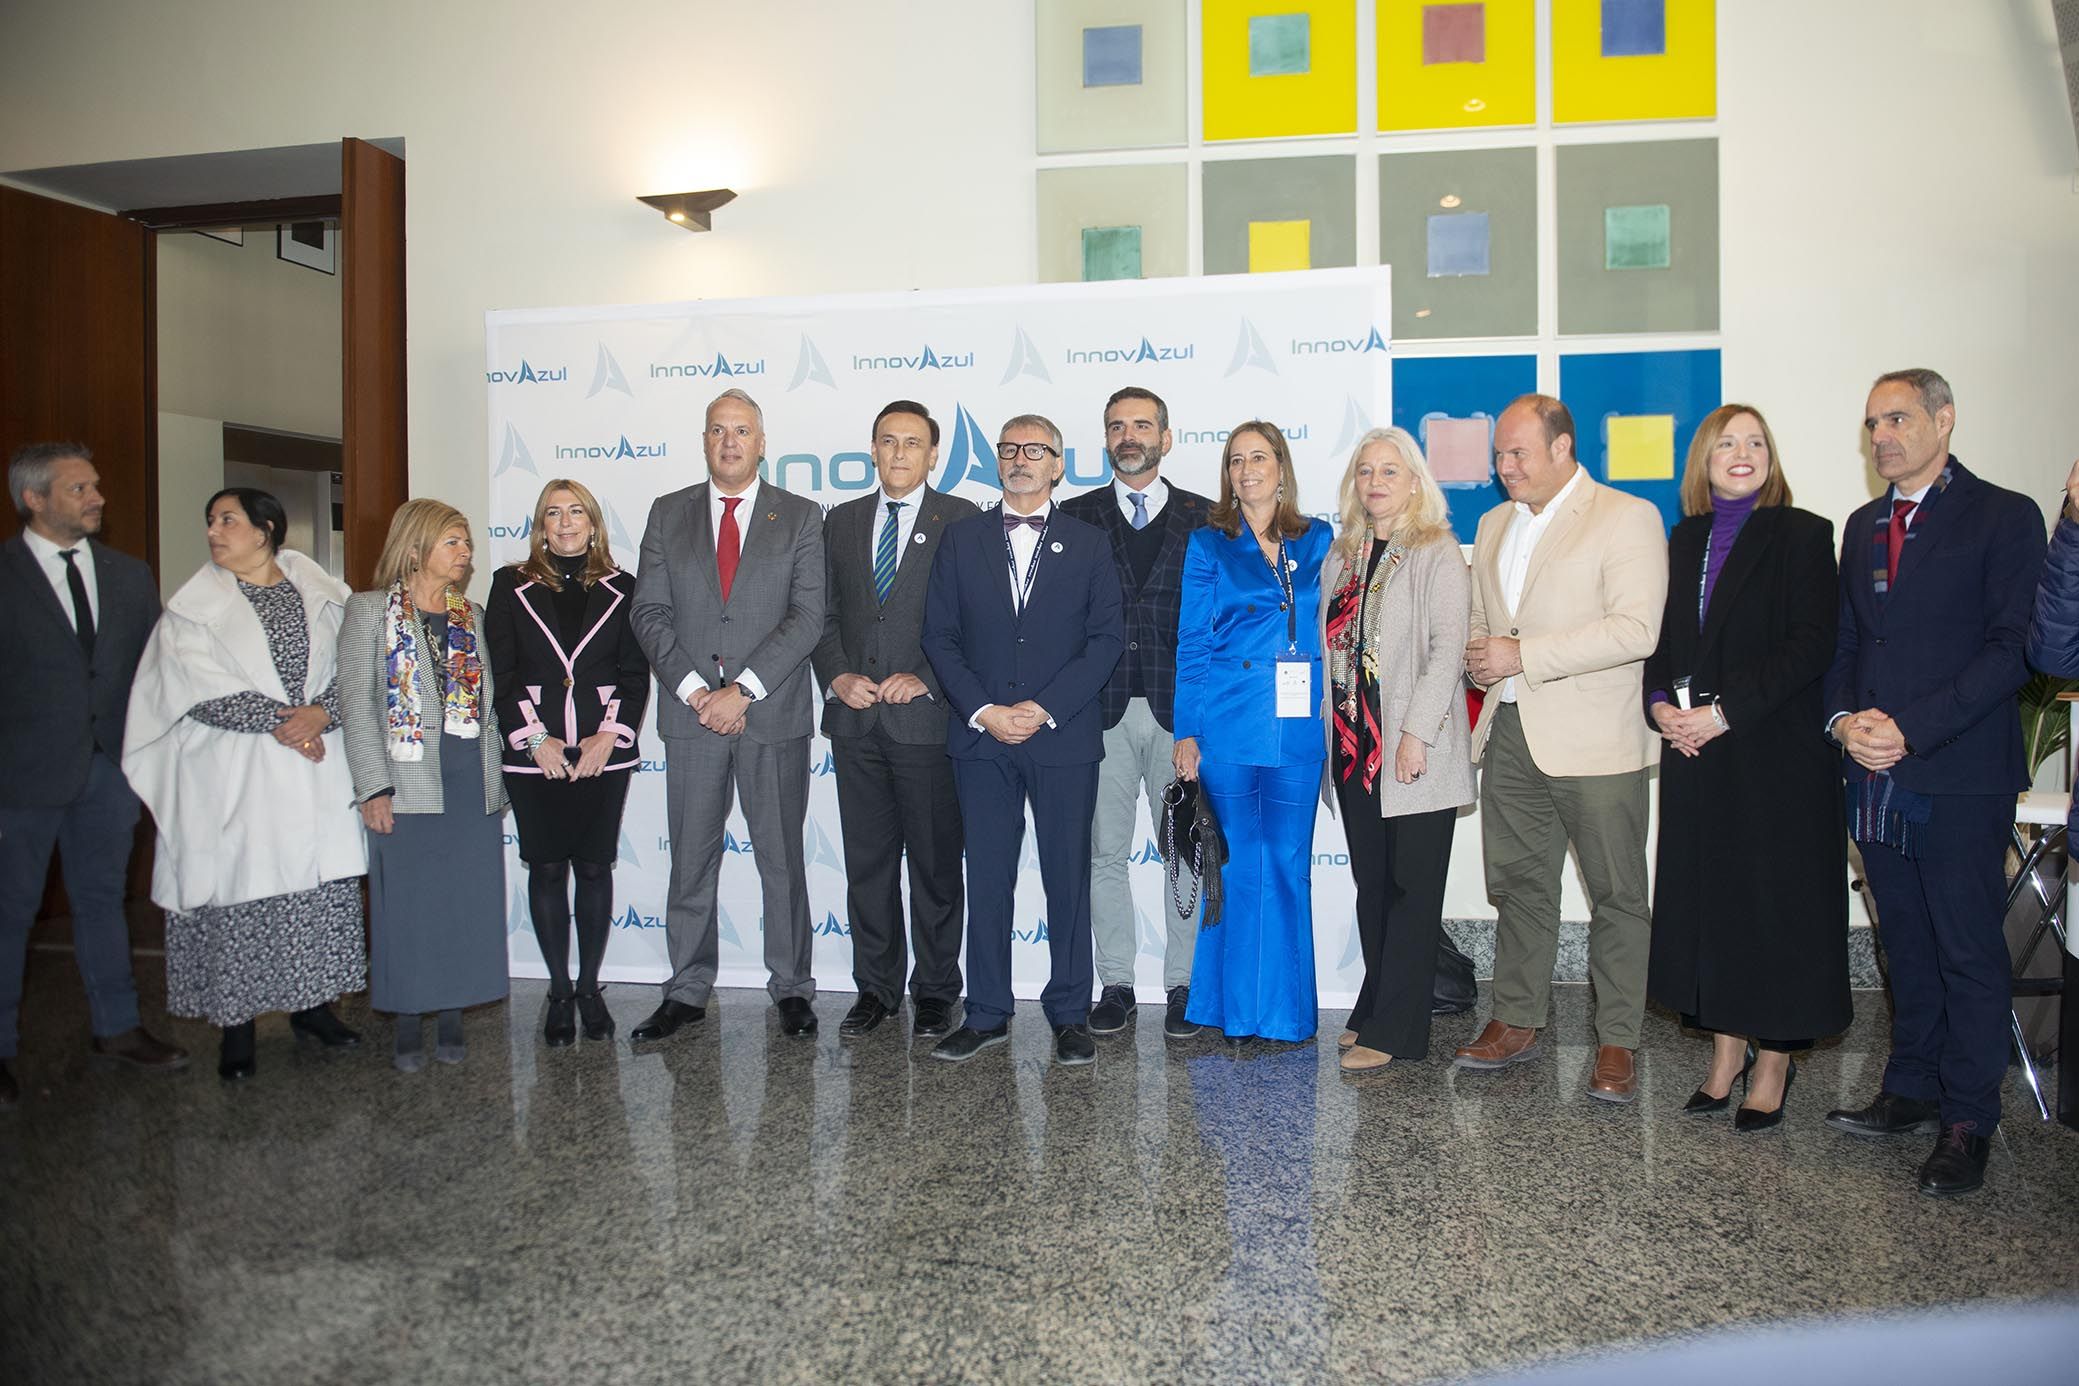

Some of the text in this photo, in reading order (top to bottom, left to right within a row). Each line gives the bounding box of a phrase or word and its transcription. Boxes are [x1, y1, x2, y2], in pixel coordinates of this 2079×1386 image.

[1066, 335, 1194, 364] InnovAzul
[1291, 325, 1392, 354] InnovA
[650, 351, 765, 378] InnovAzul
[852, 344, 974, 371] InnovAzul
[486, 359, 567, 385] ovAzul
[1178, 418, 1309, 444] Innoul
[555, 433, 667, 461] InnovAzul
